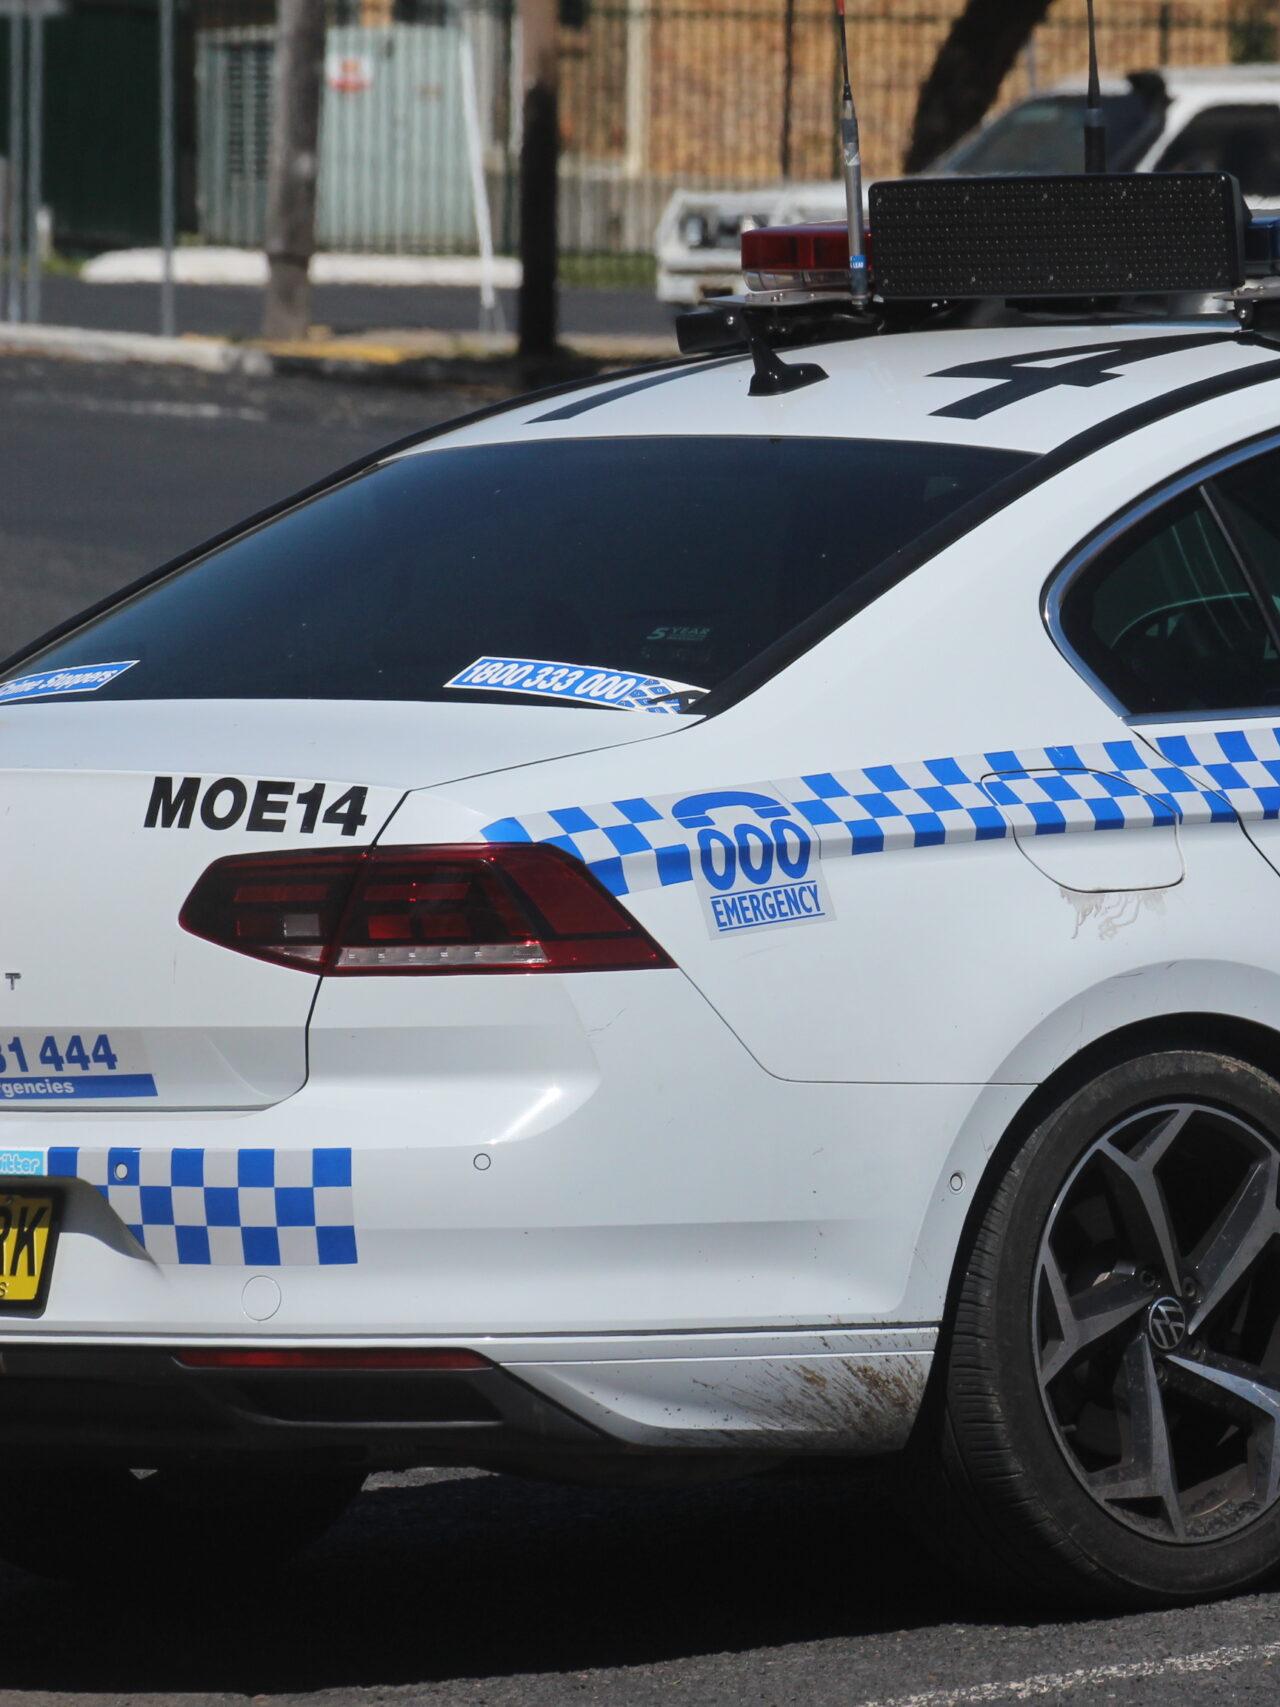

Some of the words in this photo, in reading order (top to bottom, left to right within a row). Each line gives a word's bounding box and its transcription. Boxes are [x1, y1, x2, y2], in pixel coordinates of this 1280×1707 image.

[462, 662, 534, 686] 1800
[522, 667, 584, 690] 333
[574, 673, 637, 700] 000
[143, 776, 369, 836] MOE14
[697, 819, 811, 891] 000
[711, 884, 821, 928] EMERGENCY
[5, 973, 21, 990] T
[39, 1034, 118, 1072] 444
[0, 1079, 75, 1098] gencies
[0, 1153, 40, 1174] itter
